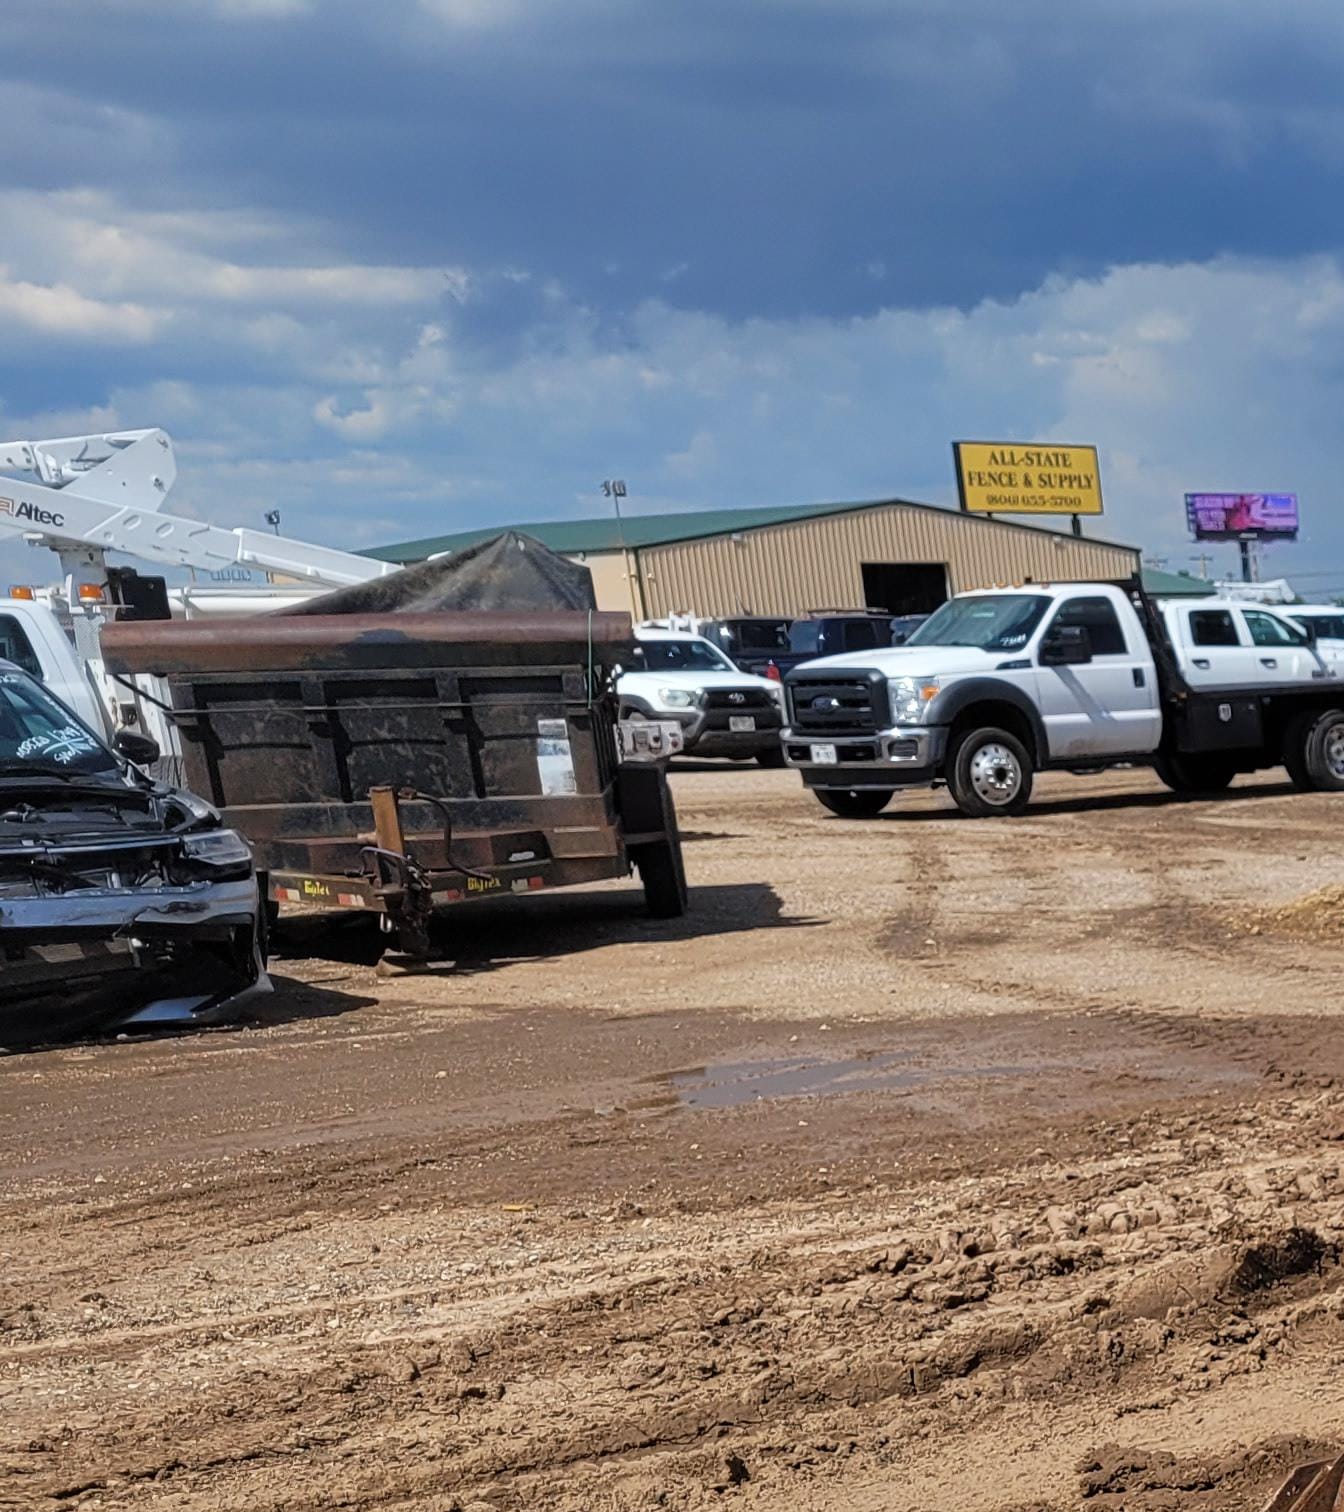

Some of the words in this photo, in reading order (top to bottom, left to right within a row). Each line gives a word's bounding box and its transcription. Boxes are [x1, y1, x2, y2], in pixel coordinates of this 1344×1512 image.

[988, 450, 1072, 468] ALL-STATE
[968, 471, 1018, 488] FENCE
[1023, 472, 1034, 488] &
[1037, 473, 1094, 489] SUPPLY
[15, 501, 65, 527] Altec
